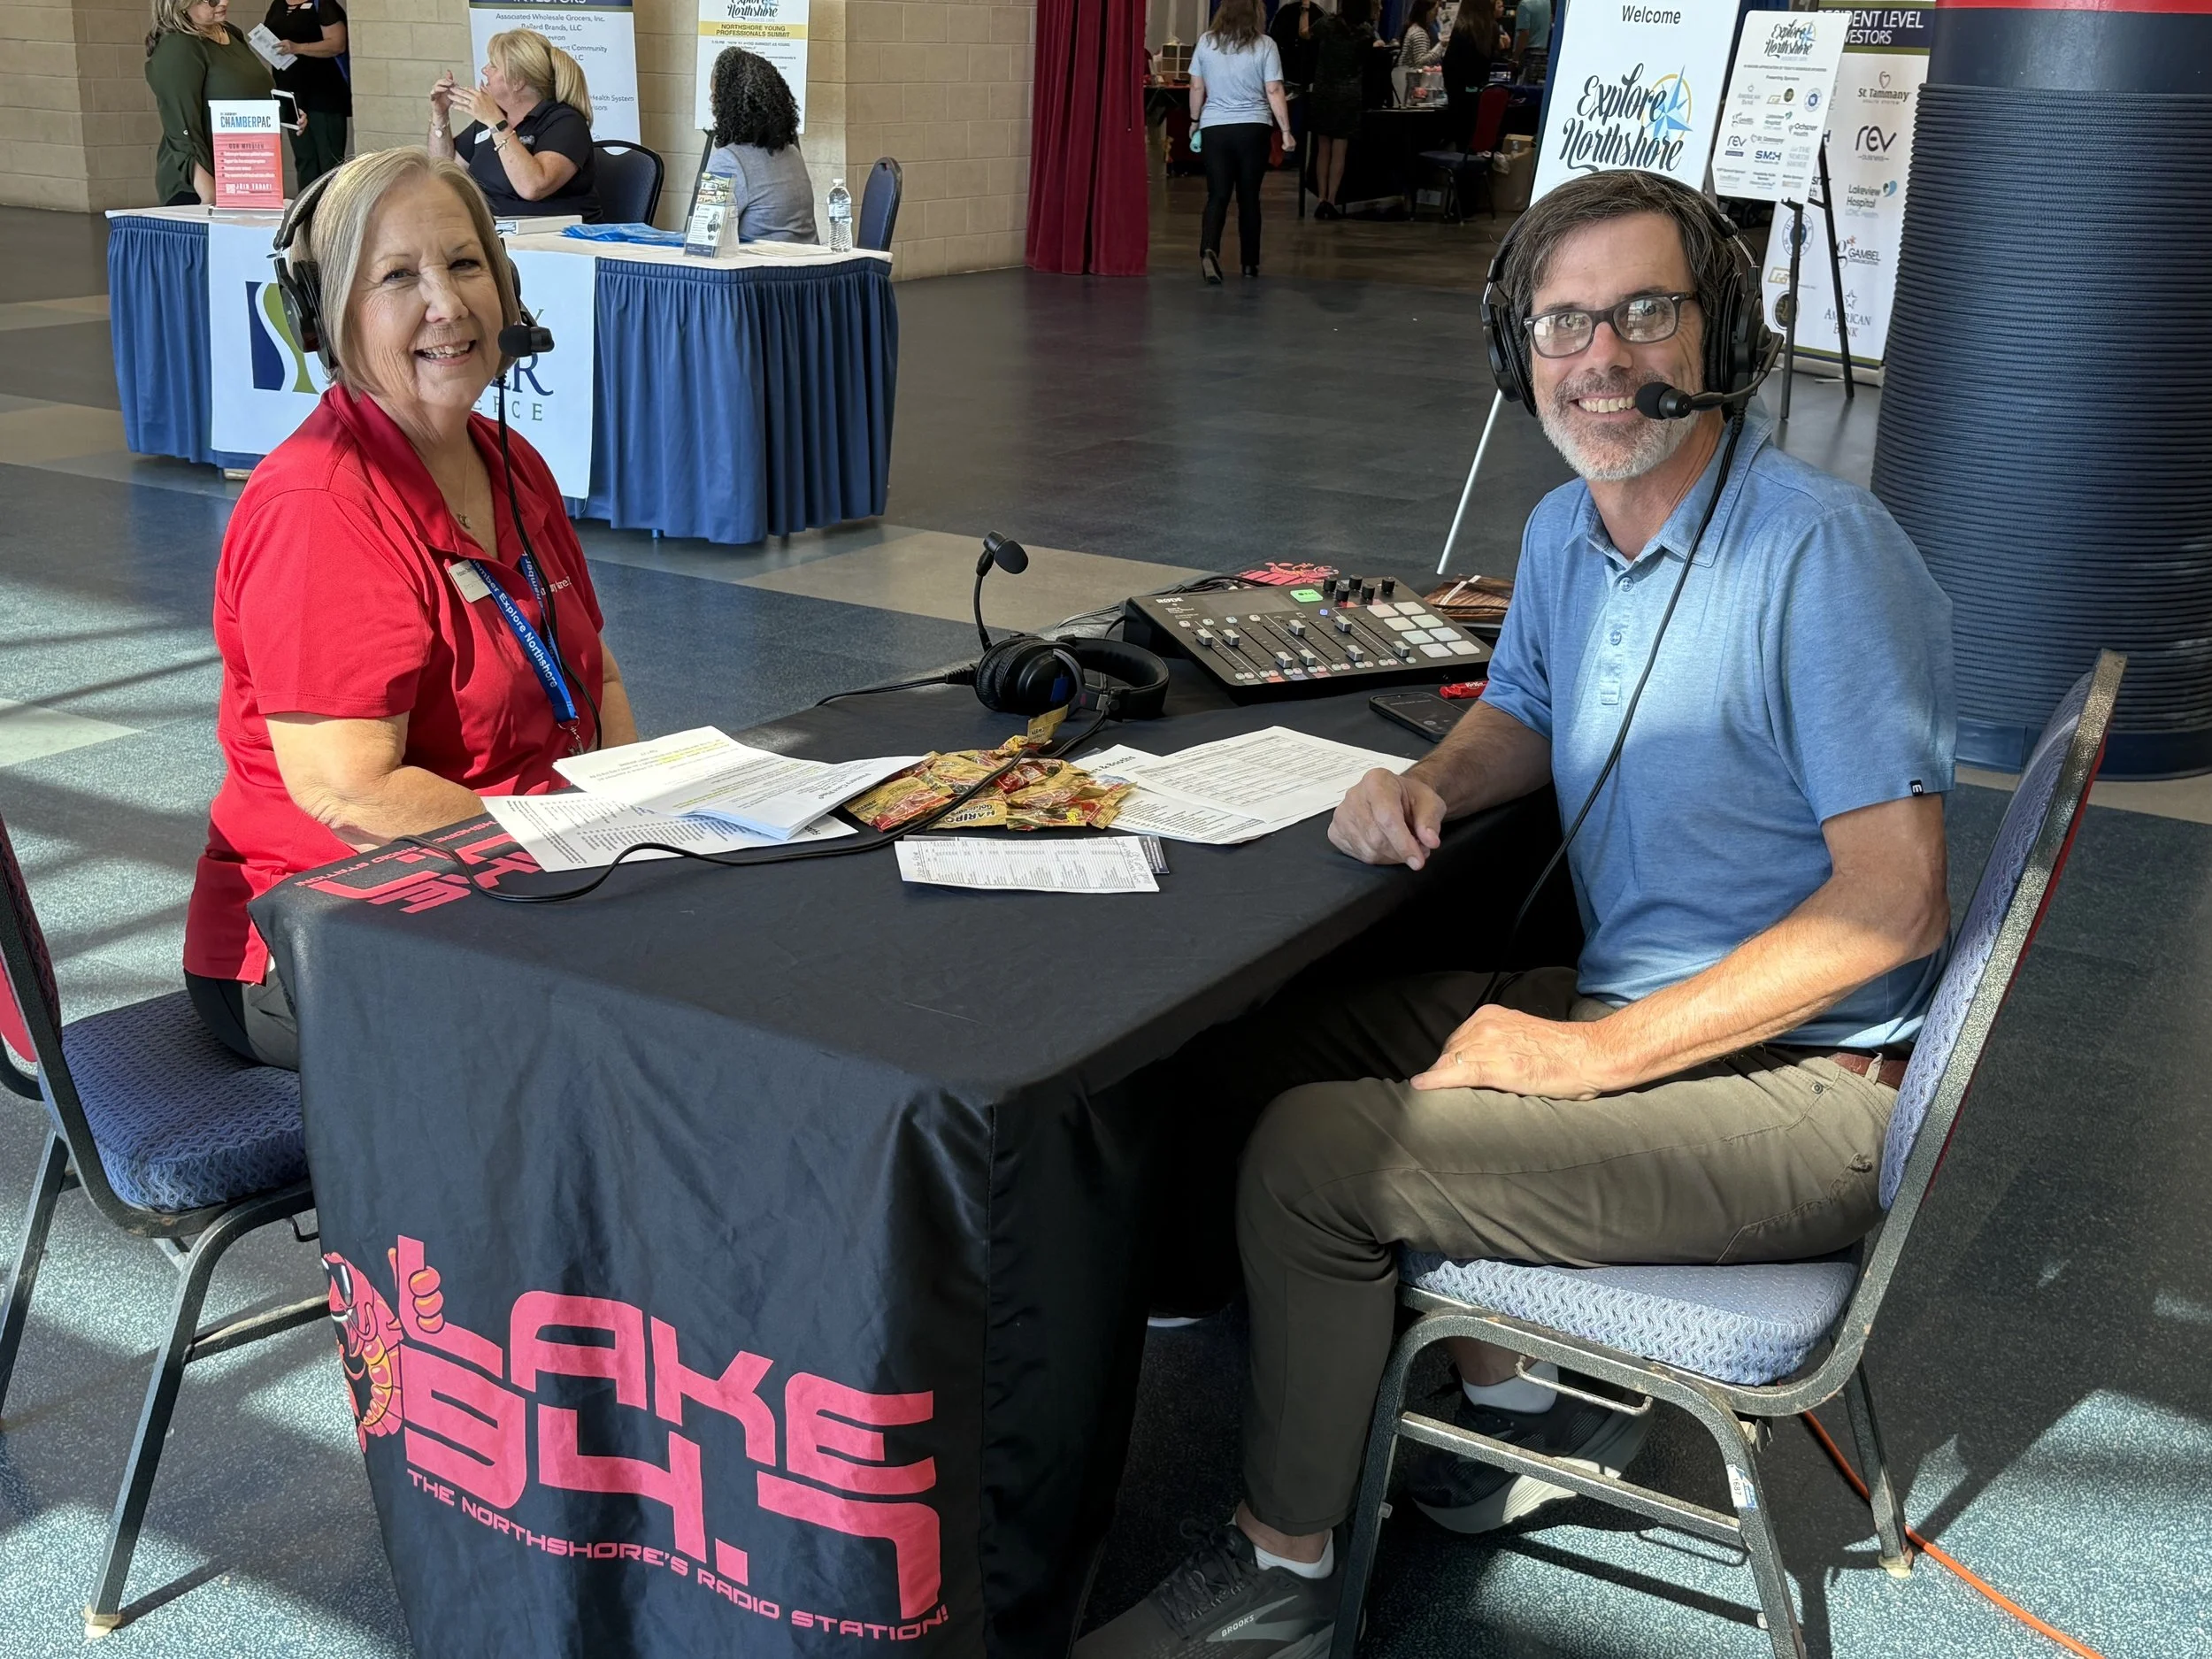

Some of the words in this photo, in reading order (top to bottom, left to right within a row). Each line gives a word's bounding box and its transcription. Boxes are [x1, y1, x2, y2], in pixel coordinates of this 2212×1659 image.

[1622, 5, 1681, 24] Welcome
[1883, 11, 1924, 28] LEVEL
[1577, 63, 1668, 126] Explore
[1858, 88, 1867, 97] St
[1869, 88, 1909, 103] Tammany
[220, 116, 272, 128] CHAMBERPAC
[1559, 118, 1684, 172] Northshore
[1848, 184, 1882, 196] Lakeview
[1847, 196, 1877, 209] Hospital
[1848, 249, 1881, 261] GAMBEL
[498, 593, 526, 633] Explore
[524, 633, 558, 687] Northshore
[397, 1235, 937, 1494] LAKE
[400, 1345, 941, 1619] 94.7
[1732, 1478, 1742, 1495] 1687
[406, 1468, 455, 1508] THE
[461, 1499, 689, 1577] NORTHSHORE'S
[697, 1568, 780, 1621] RADIO
[791, 1603, 949, 1641] STATION!
[1221, 1614, 1255, 1637] BROOKS
